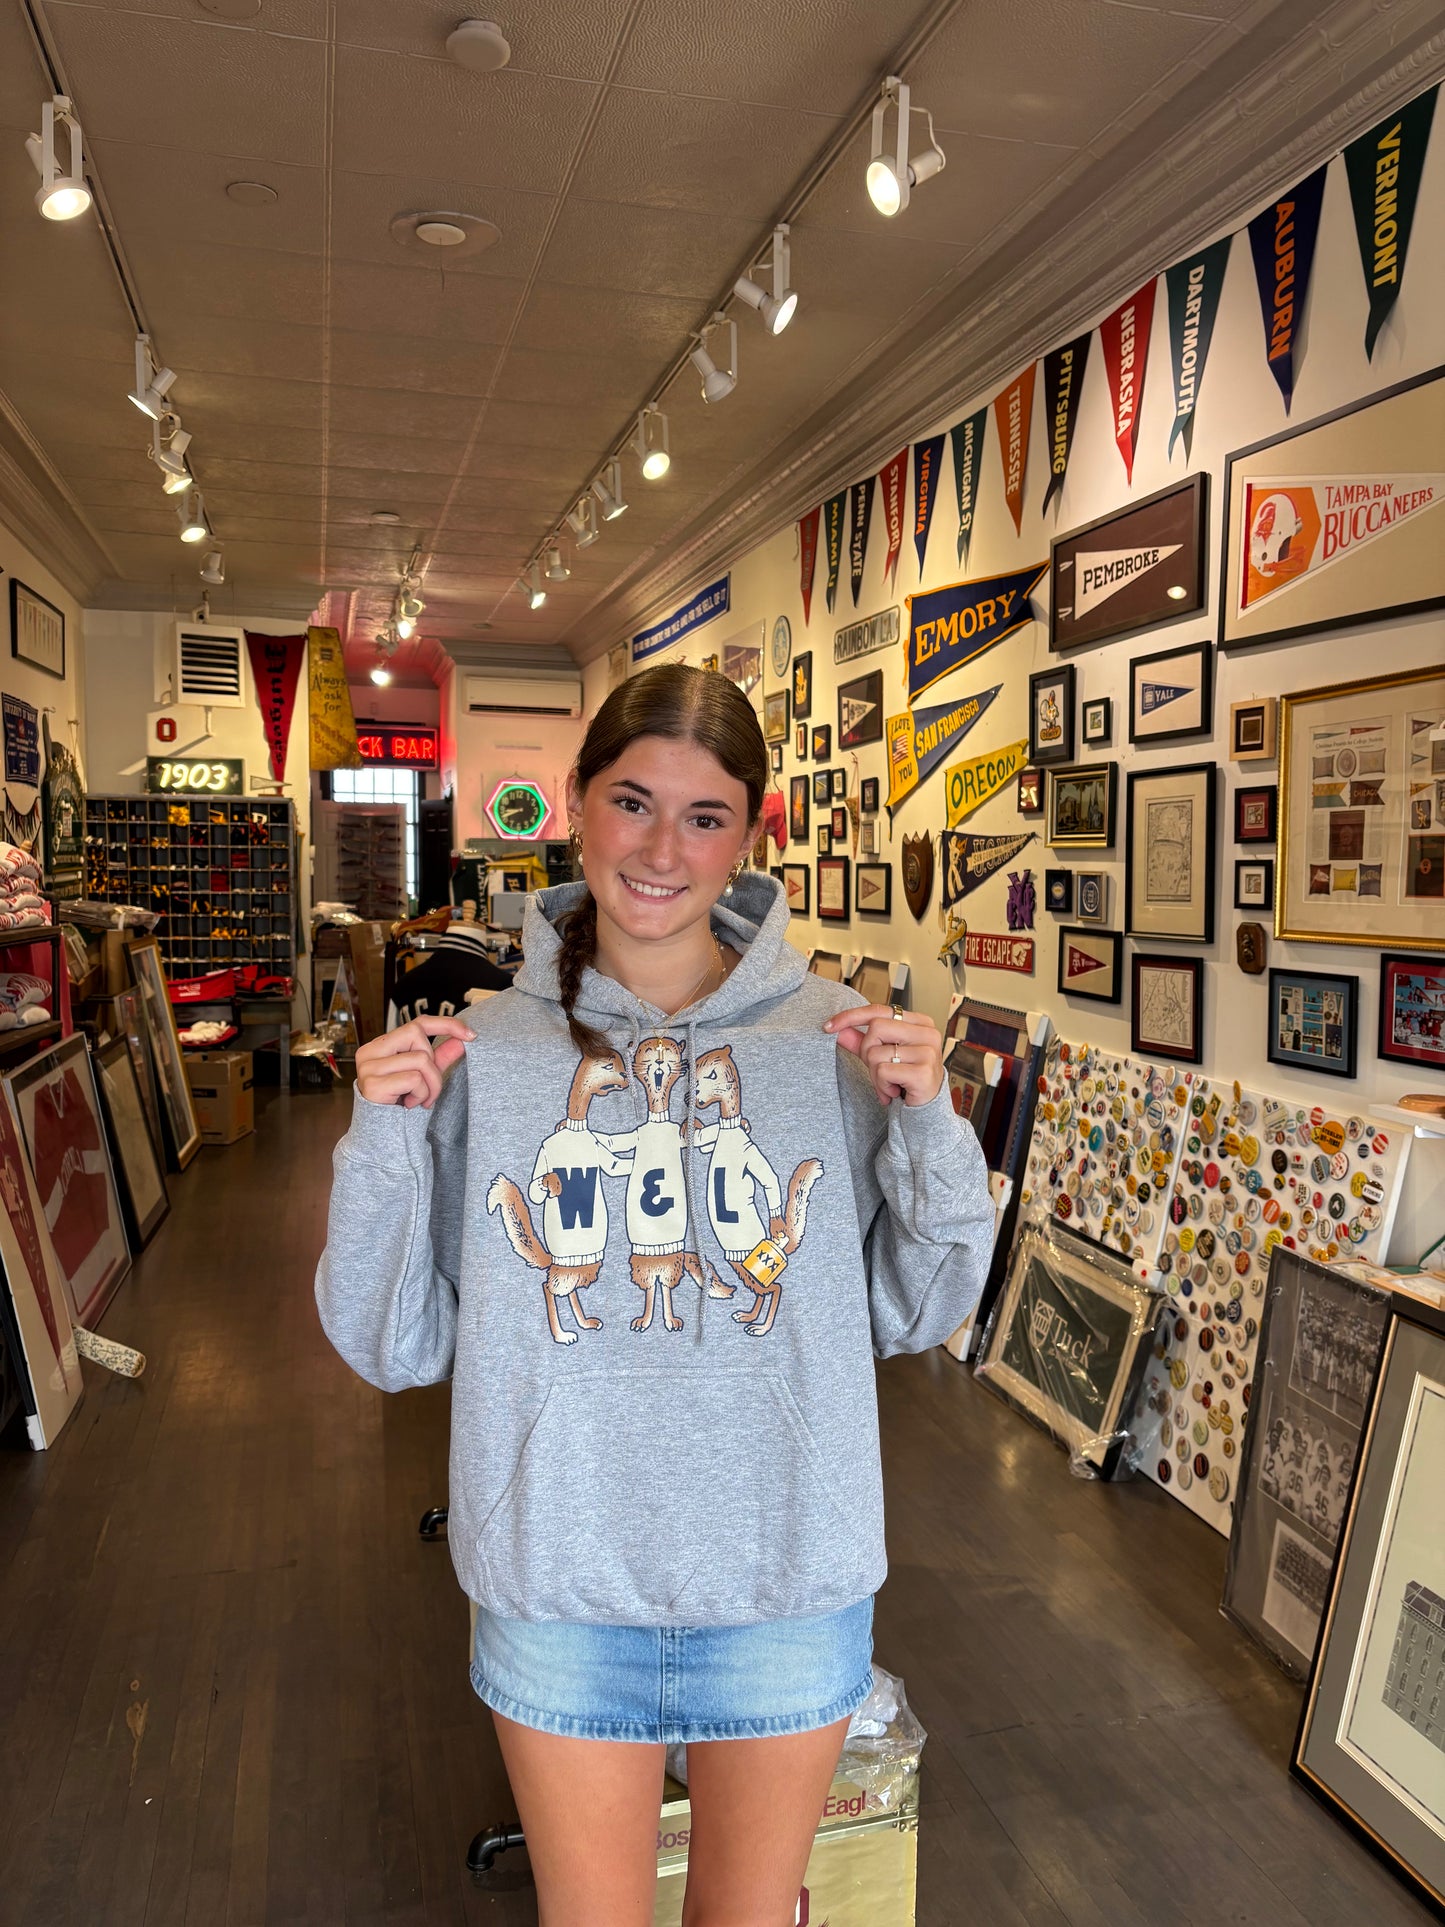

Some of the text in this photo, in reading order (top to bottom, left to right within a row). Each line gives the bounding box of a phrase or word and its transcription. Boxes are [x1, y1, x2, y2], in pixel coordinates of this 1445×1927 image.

[1373, 121, 1402, 288] VERMONT
[1268, 201, 1296, 362] AUBURN
[1176, 264, 1205, 417] DARTMOUTH
[1116, 305, 1136, 438] NEBRASKA
[1053, 349, 1074, 475] PITTSBURG
[1006, 385, 1021, 496] TENNESSEE
[915, 447, 932, 536] VIRGINIA
[959, 421, 974, 536] MICHIGAN ST.
[1325, 482, 1394, 510] TAMPA BAY
[830, 502, 839, 567] MIAMI
[852, 483, 866, 577] PENN STATE
[889, 463, 901, 553] STANFORD
[1322, 487, 1434, 561] BUCCANEERS
[1082, 549, 1160, 595] PEMBROKE
[914, 590, 1016, 666] EMORY
[311, 672, 346, 692] Always
[323, 701, 341, 715] for
[324, 691, 342, 700] ask
[1155, 689, 1175, 702] YALE
[391, 735, 434, 760] BAR
[894, 717, 911, 735] LOVE
[914, 699, 980, 760] SAN FRANCISCO
[159, 762, 230, 791] 1903
[516, 790, 524, 799] 12
[897, 767, 913, 784] YOU
[965, 935, 1011, 964] FIRE ESCAPE
[552, 1167, 740, 1231] W & L
[757, 1250, 780, 1273] XXX
[1053, 1314, 1094, 1370] Tuck
[823, 1790, 866, 1818] Eagl
[656, 1829, 691, 1850] Bos
